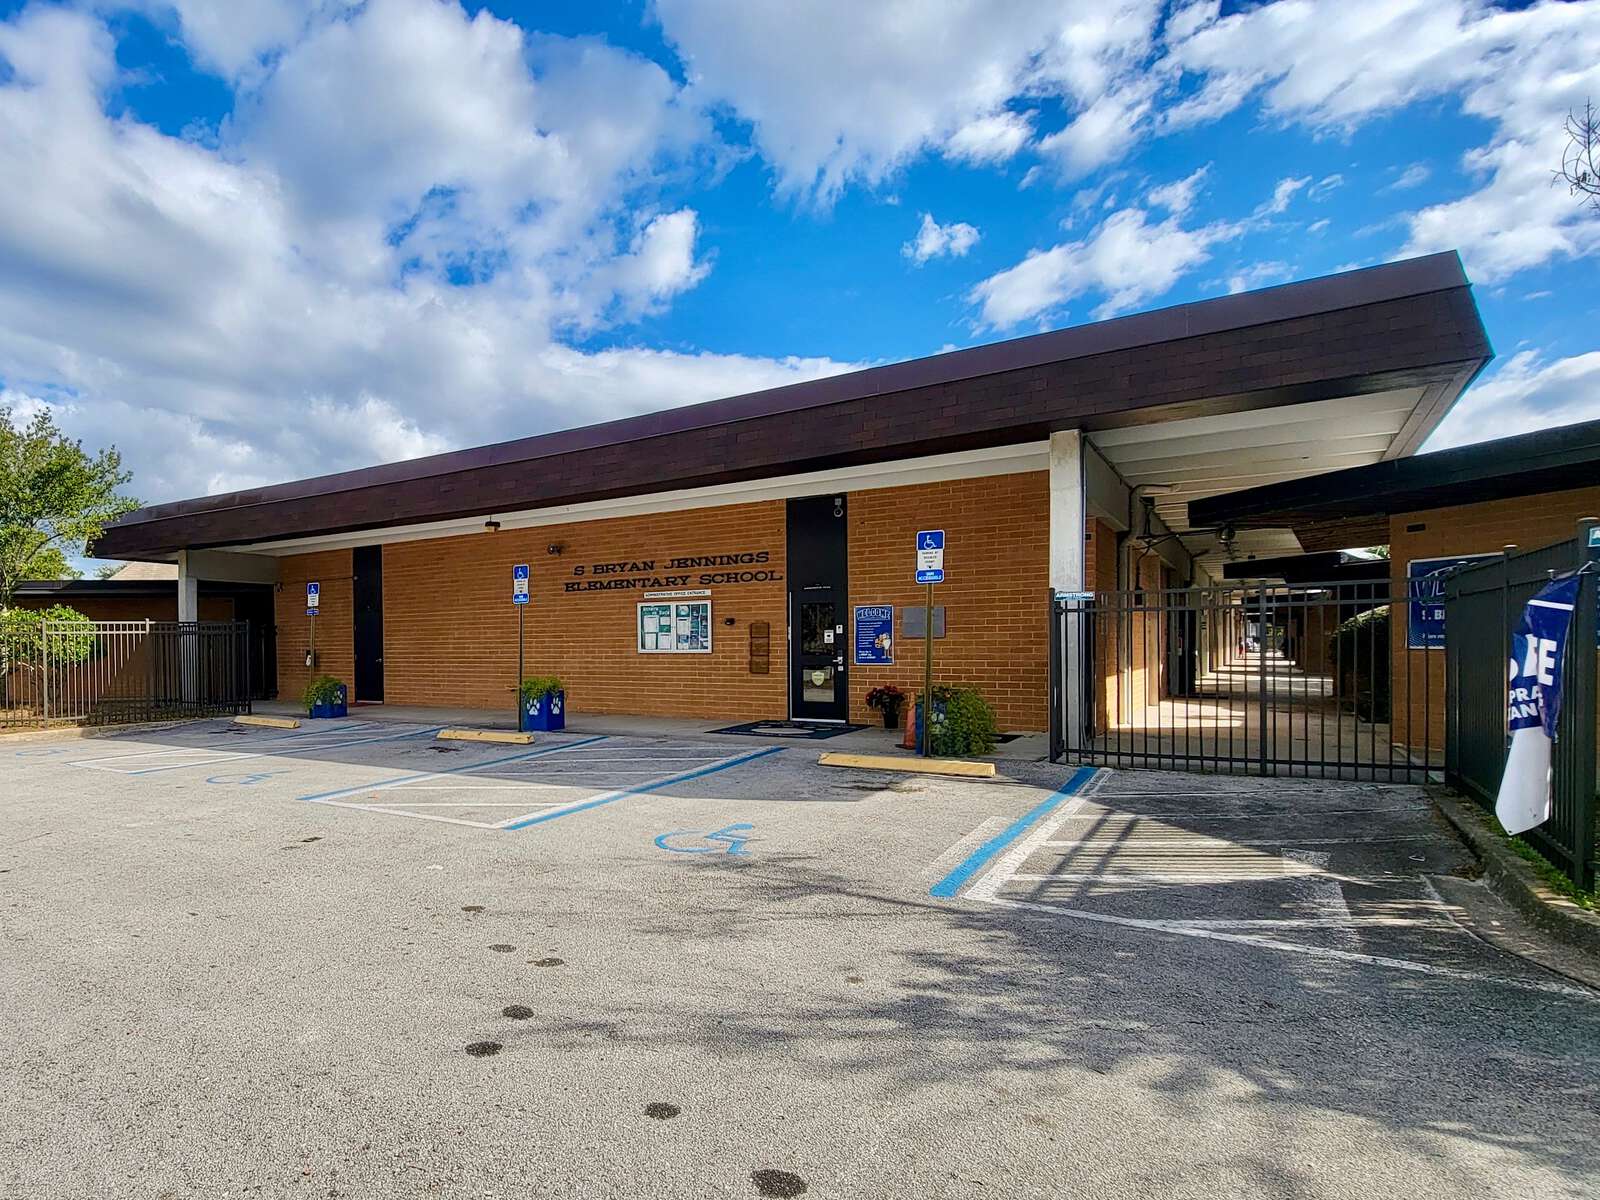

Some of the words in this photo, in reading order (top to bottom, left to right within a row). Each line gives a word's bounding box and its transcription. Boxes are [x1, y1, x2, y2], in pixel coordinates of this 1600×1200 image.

[573, 565, 585, 576] S
[592, 560, 656, 575] BRYAN
[663, 552, 769, 570] JENNINGS
[565, 575, 691, 592] ELEMENTARY
[699, 570, 783, 585] SCHOOL
[856, 608, 890, 620] WELCOME
